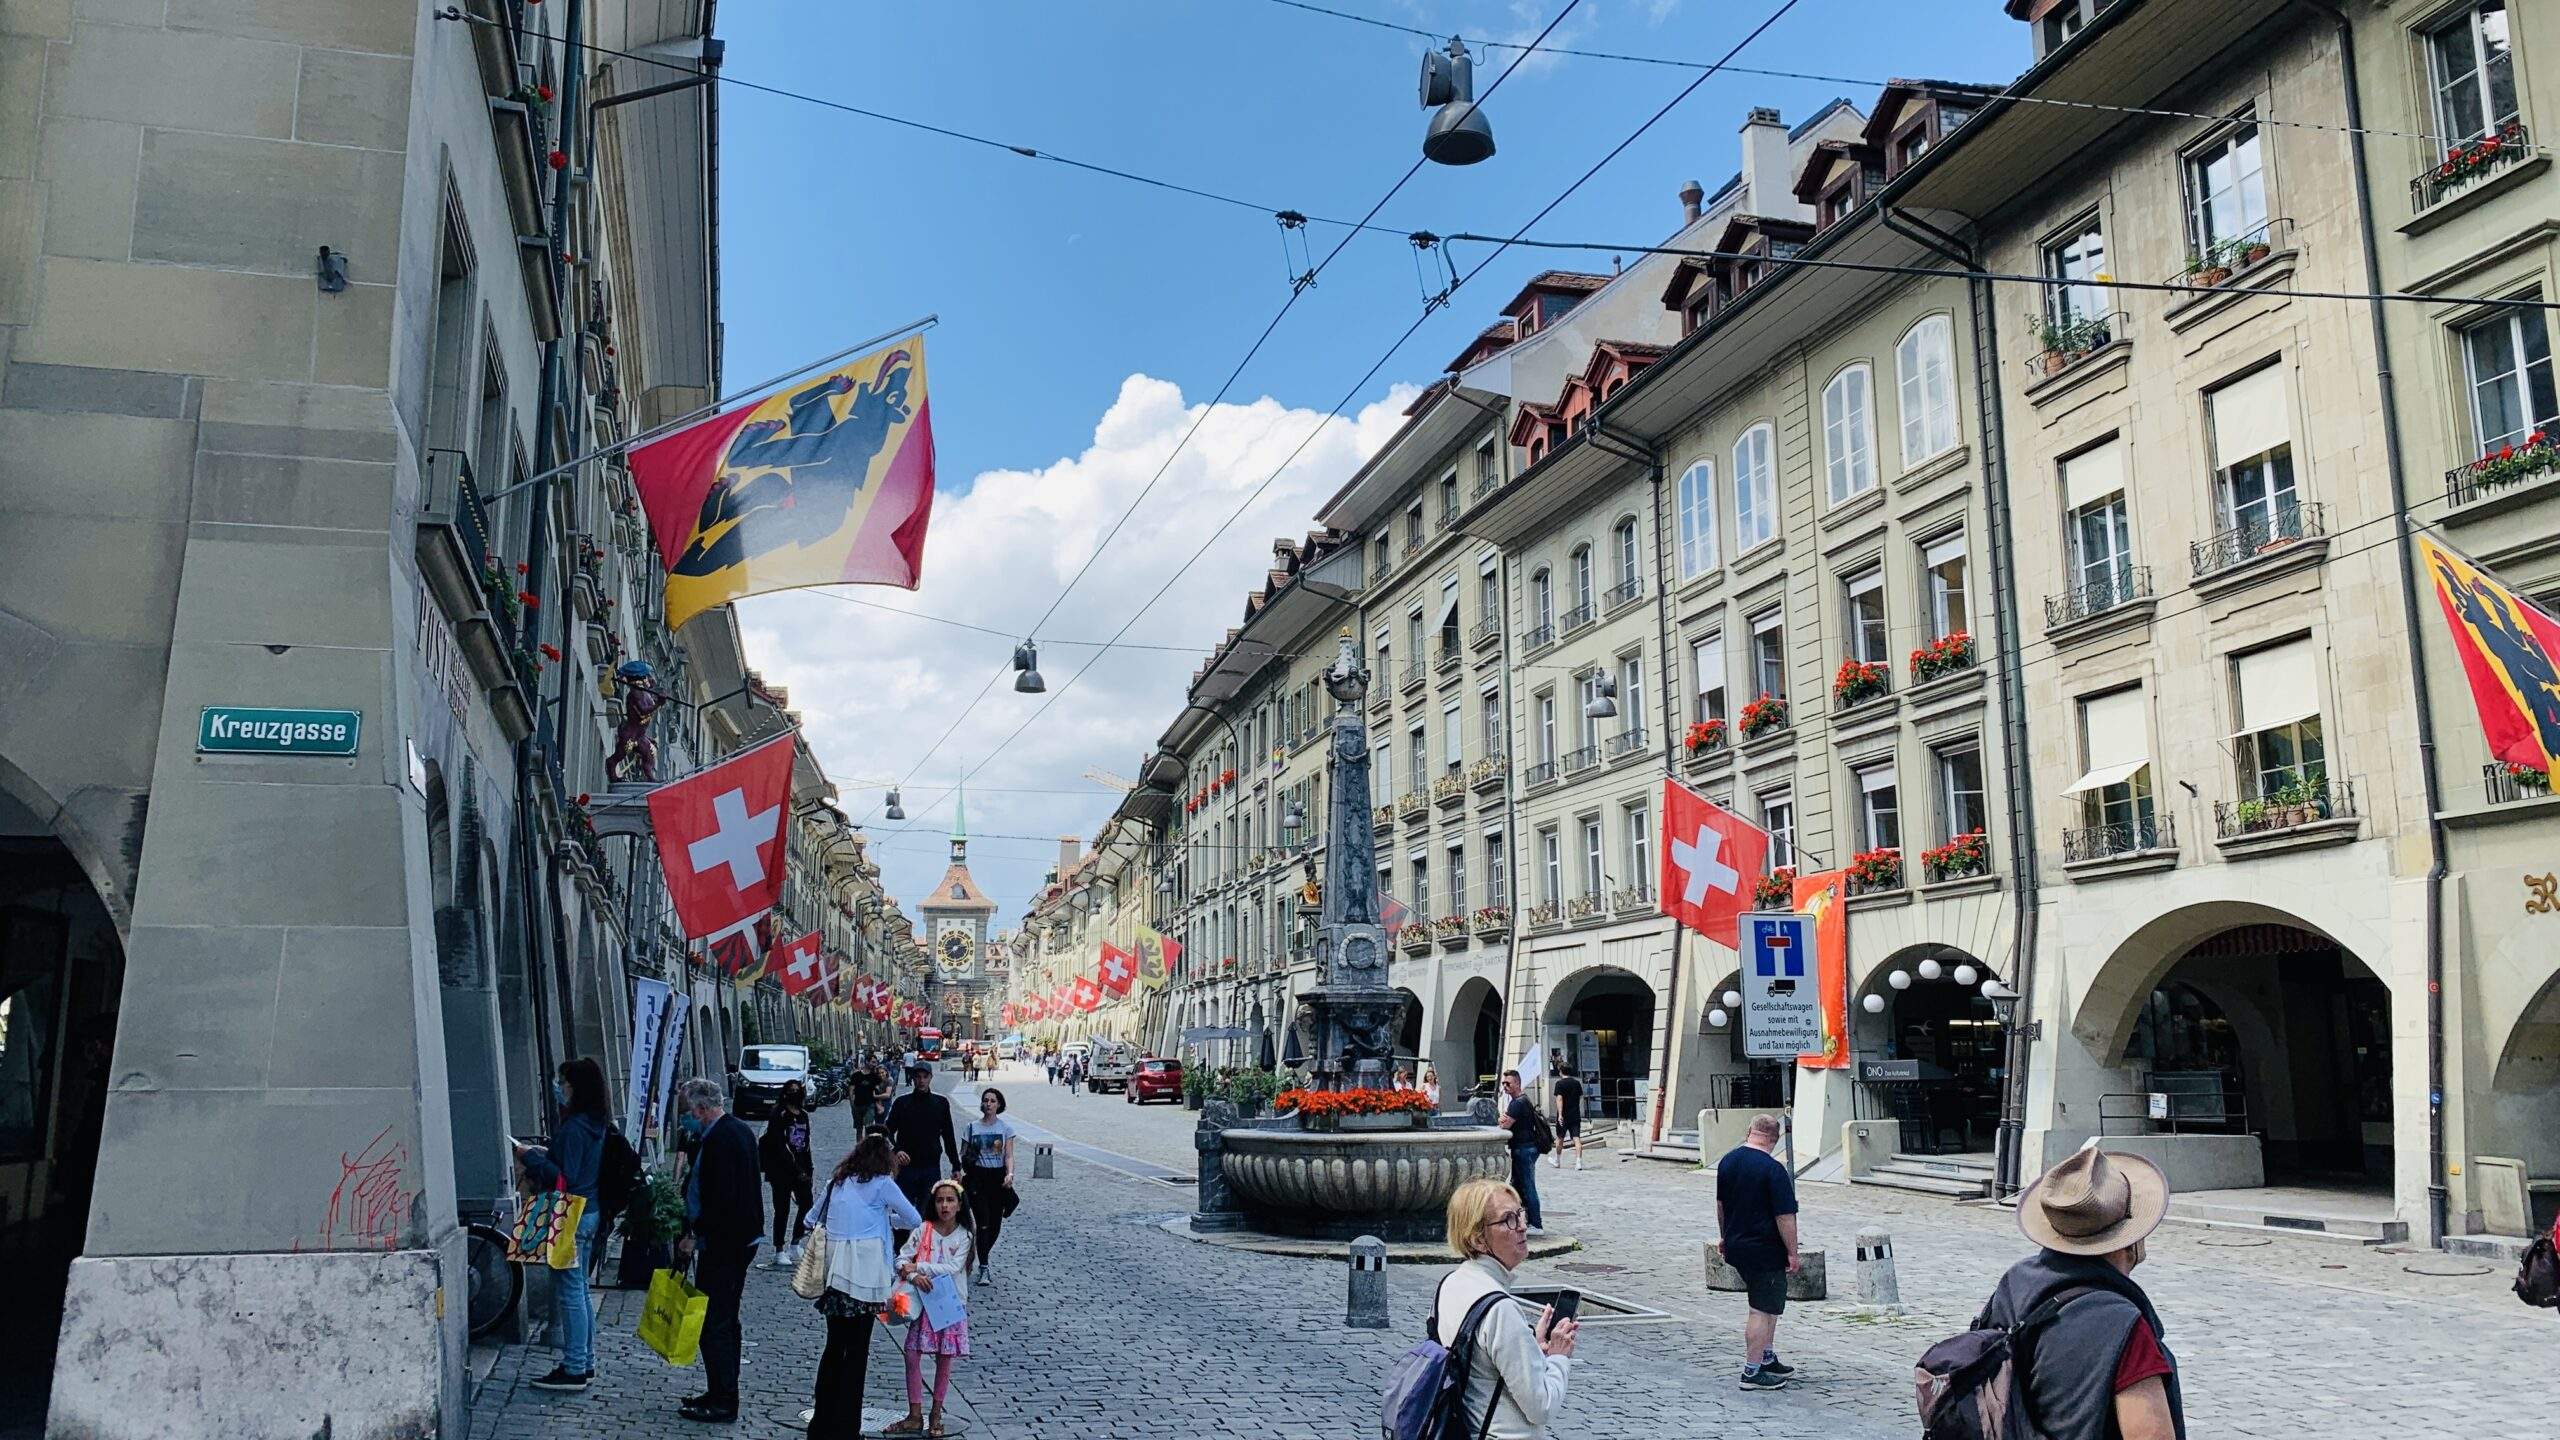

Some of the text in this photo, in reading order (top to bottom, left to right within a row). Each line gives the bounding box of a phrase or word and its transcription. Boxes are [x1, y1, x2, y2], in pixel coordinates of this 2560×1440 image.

[210, 714, 346, 745] Kreuzgasse
[1751, 1001, 1813, 1013] Gesellschaftswagen
[1768, 1015, 1799, 1024] sowie mit
[1749, 1028, 1819, 1039] Ausnahmebewilligung
[1758, 1040, 1811, 1051] und Taxi möglich
[1866, 1066, 1883, 1077] ONO
